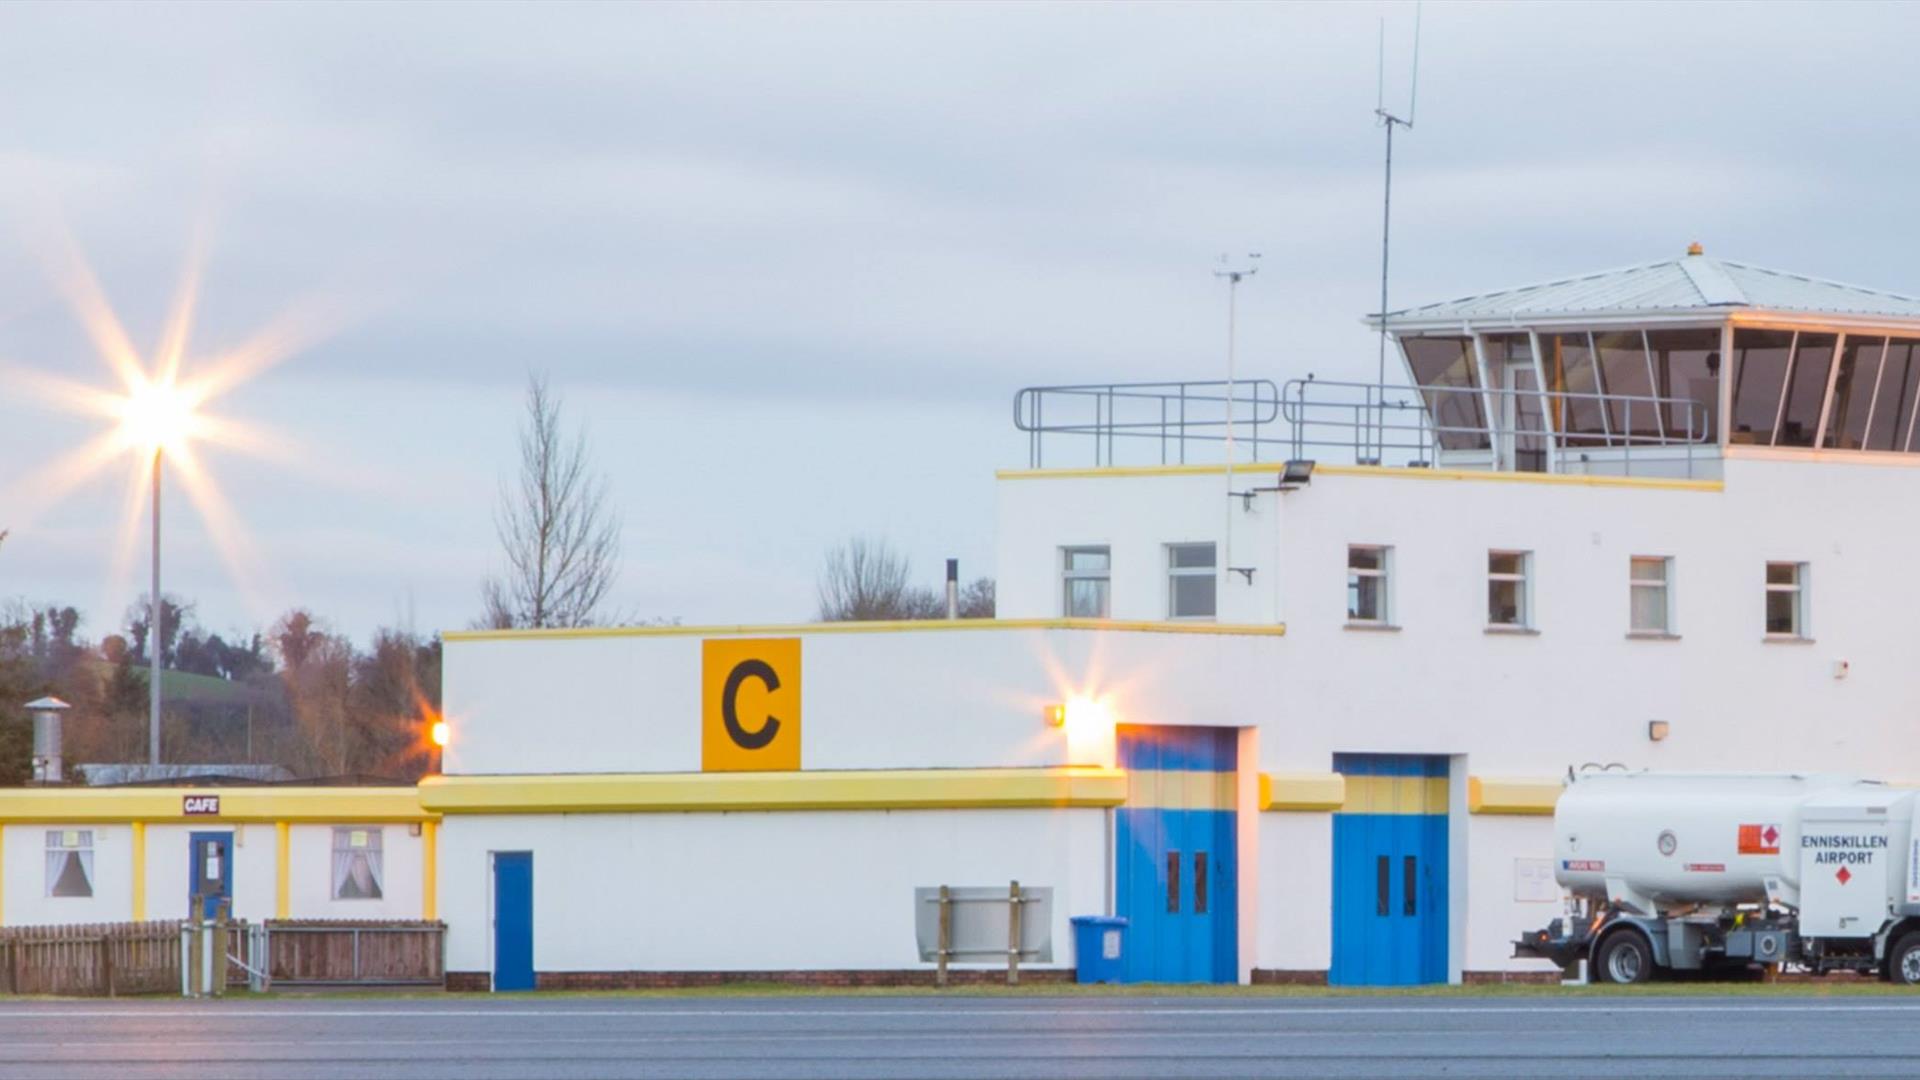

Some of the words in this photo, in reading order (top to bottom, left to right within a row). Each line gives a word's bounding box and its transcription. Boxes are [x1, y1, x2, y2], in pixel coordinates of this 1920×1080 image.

[721, 658, 781, 751] C
[185, 798, 218, 812] CAFE
[1801, 835, 1888, 848] ENNISKILLEN
[1815, 851, 1873, 865] AIRPORT
